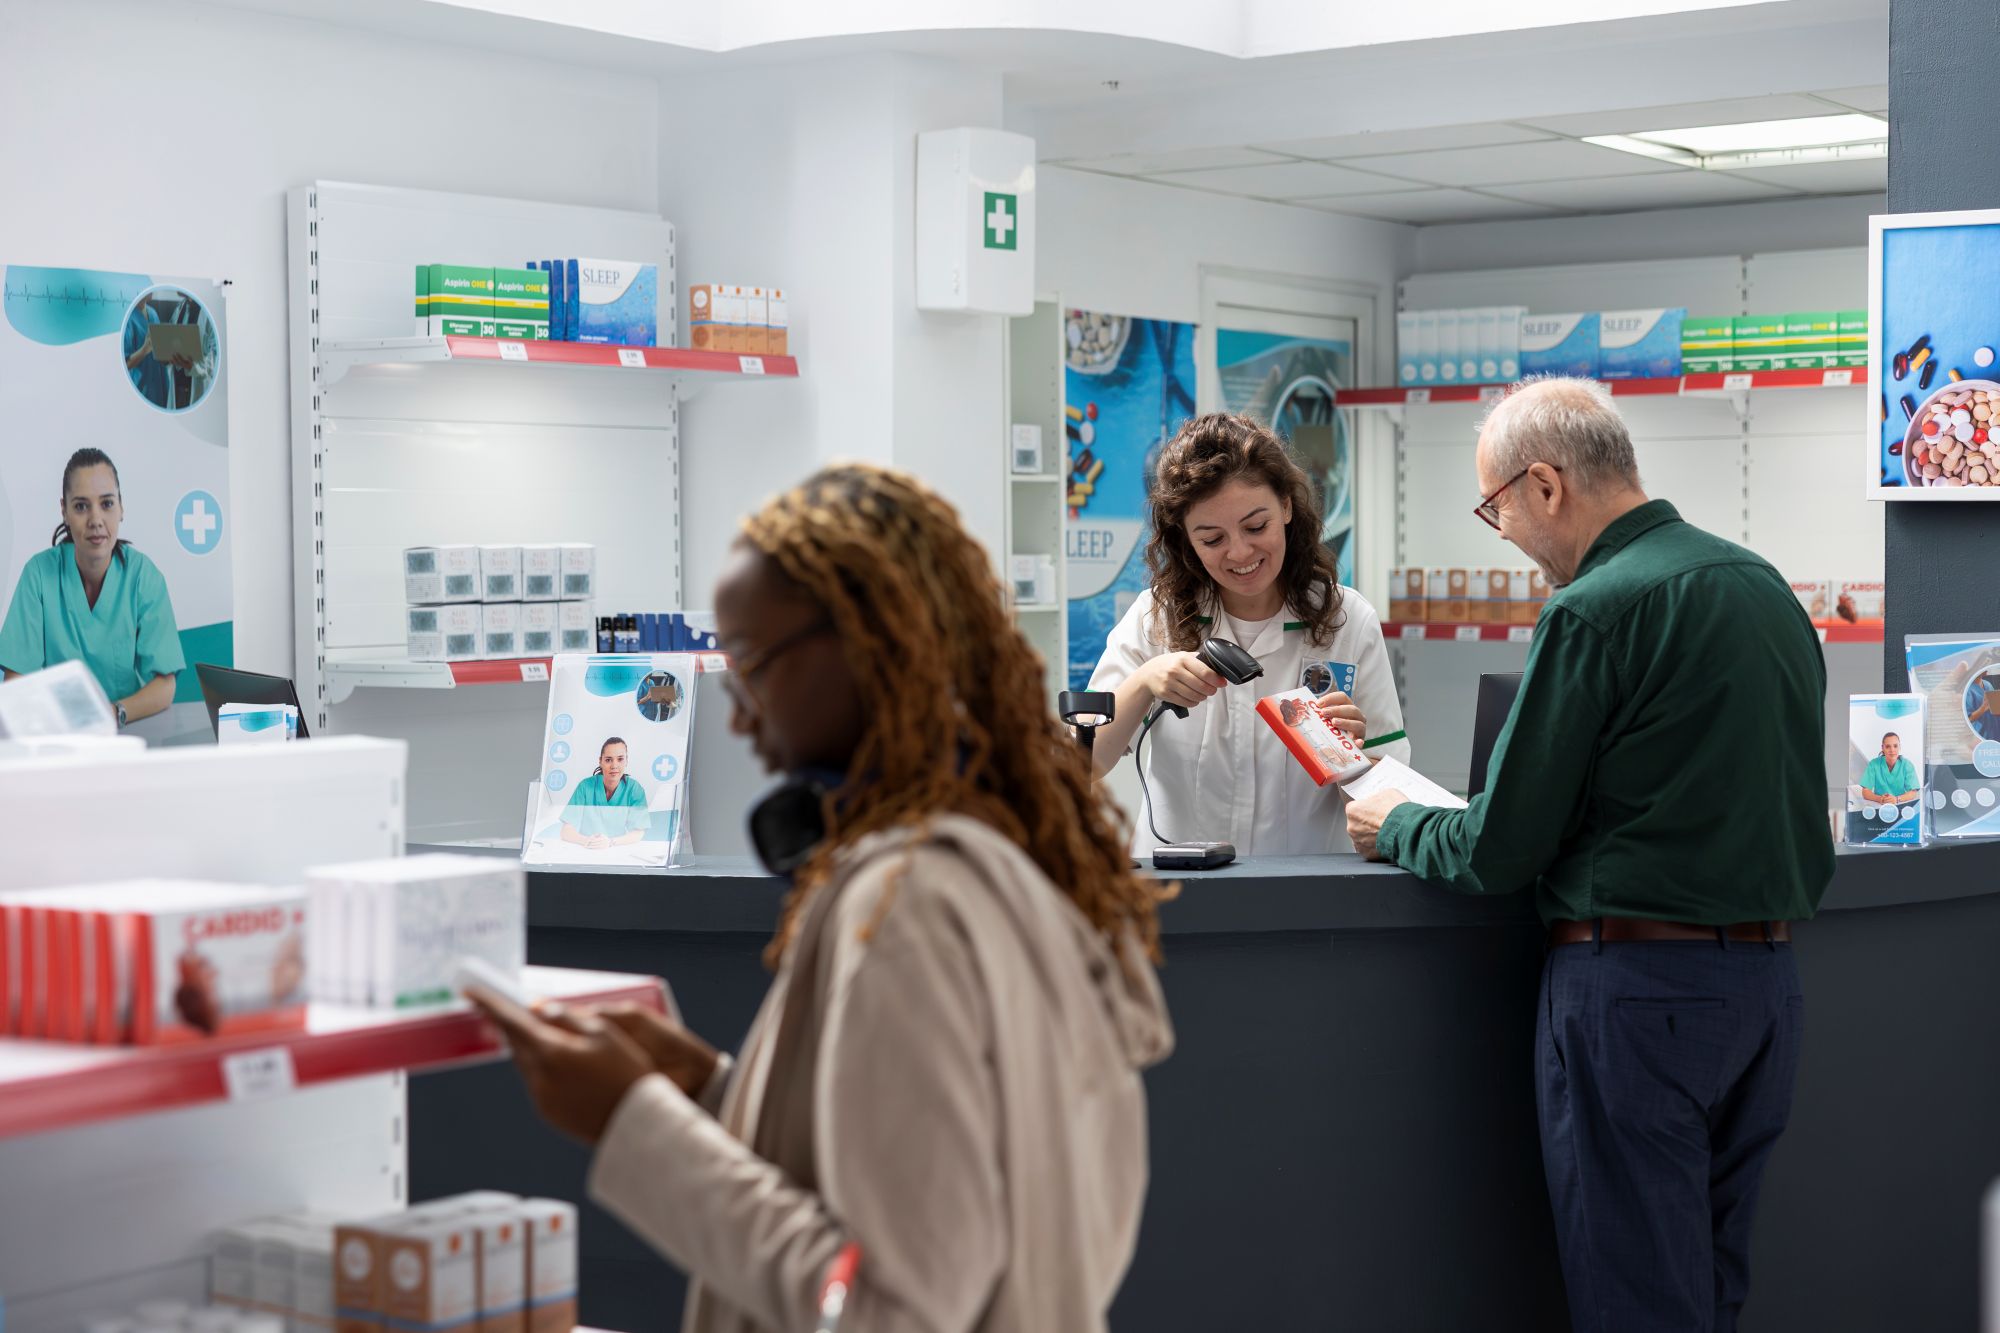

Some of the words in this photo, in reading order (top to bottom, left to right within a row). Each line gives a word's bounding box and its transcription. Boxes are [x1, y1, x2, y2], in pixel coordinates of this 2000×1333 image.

[444, 278, 470, 288] Aspirin
[471, 280, 487, 288] ONE
[583, 268, 620, 284] SLEEP
[497, 282, 524, 292] Aspirin
[525, 285, 542, 293] ONE
[483, 324, 494, 335] 30
[1523, 322, 1561, 336] SLEEP
[1604, 318, 1642, 332] SLEEP
[537, 327, 549, 338] 30
[1066, 530, 1114, 558] LEEP
[183, 907, 283, 942] CARDIO
